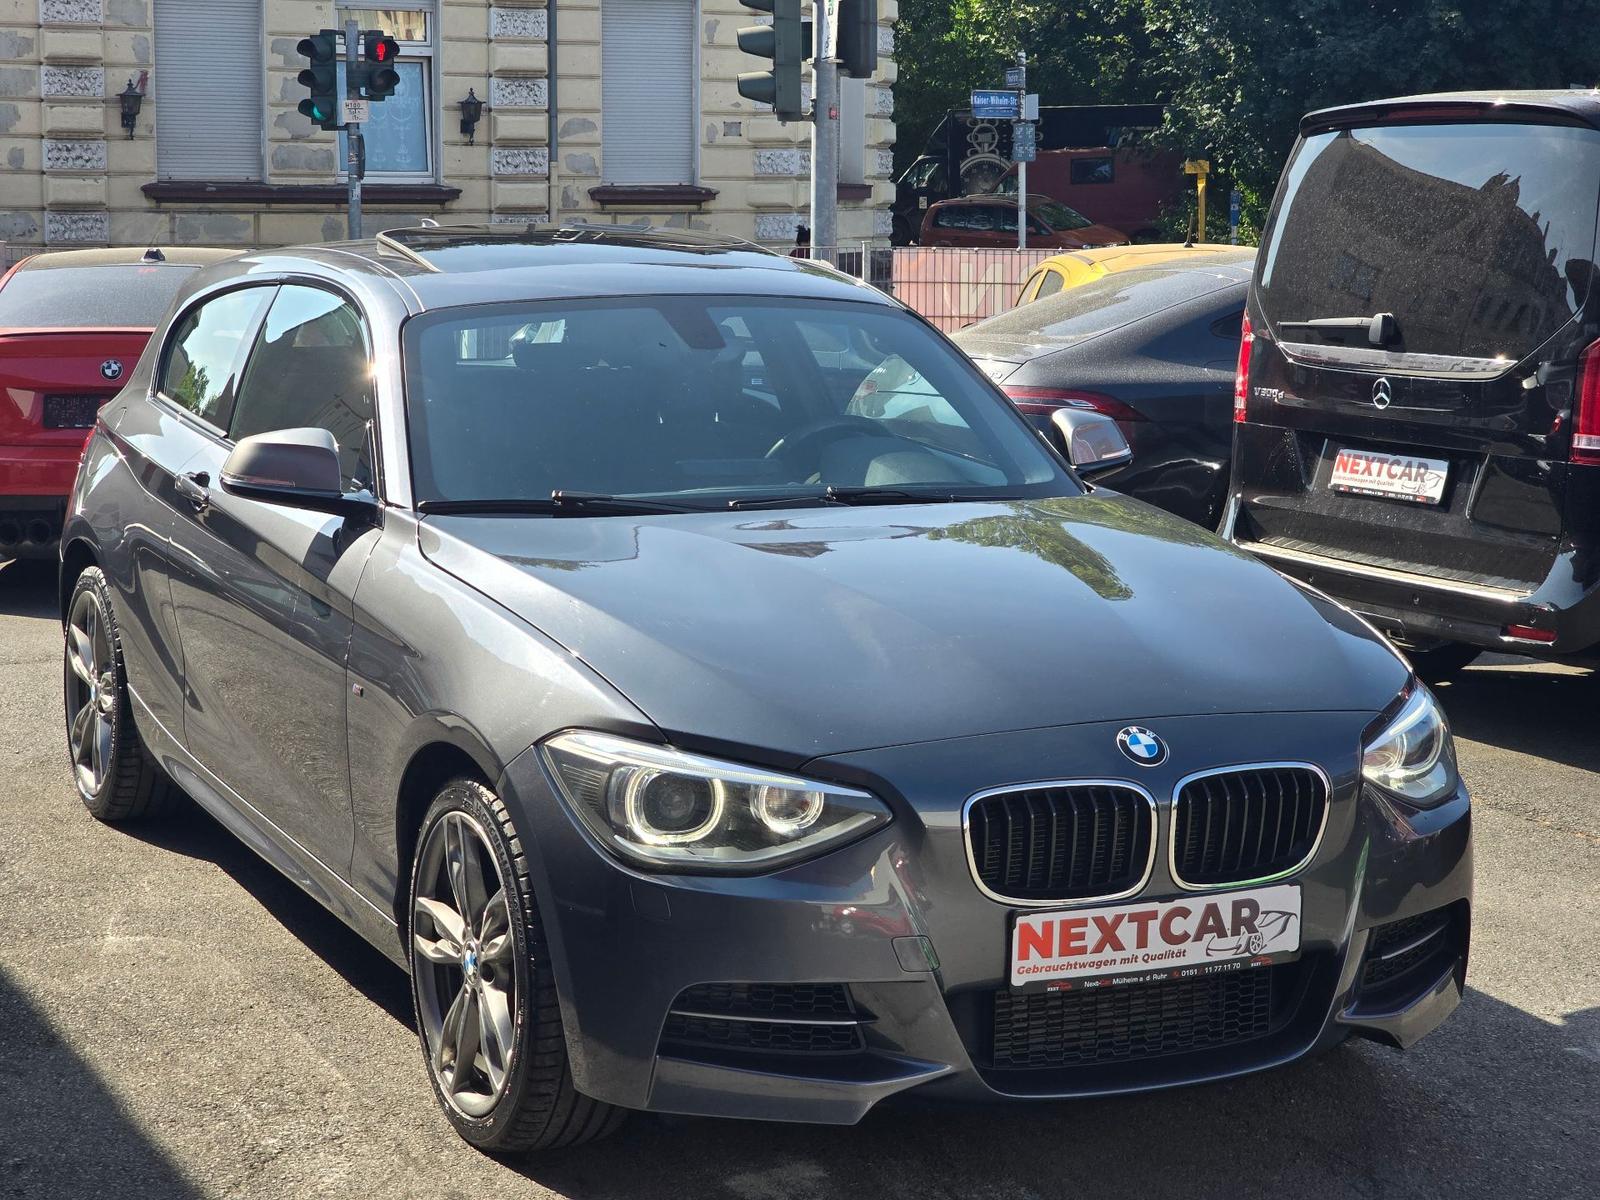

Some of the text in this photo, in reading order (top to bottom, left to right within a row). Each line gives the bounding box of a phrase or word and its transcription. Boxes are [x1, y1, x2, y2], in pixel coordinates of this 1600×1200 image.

[1335, 452, 1429, 483] NEXTCAR
[1017, 898, 1261, 961] NEXTCAR
[1016, 948, 1187, 975] Gebrauchtwagen mit Qualität
